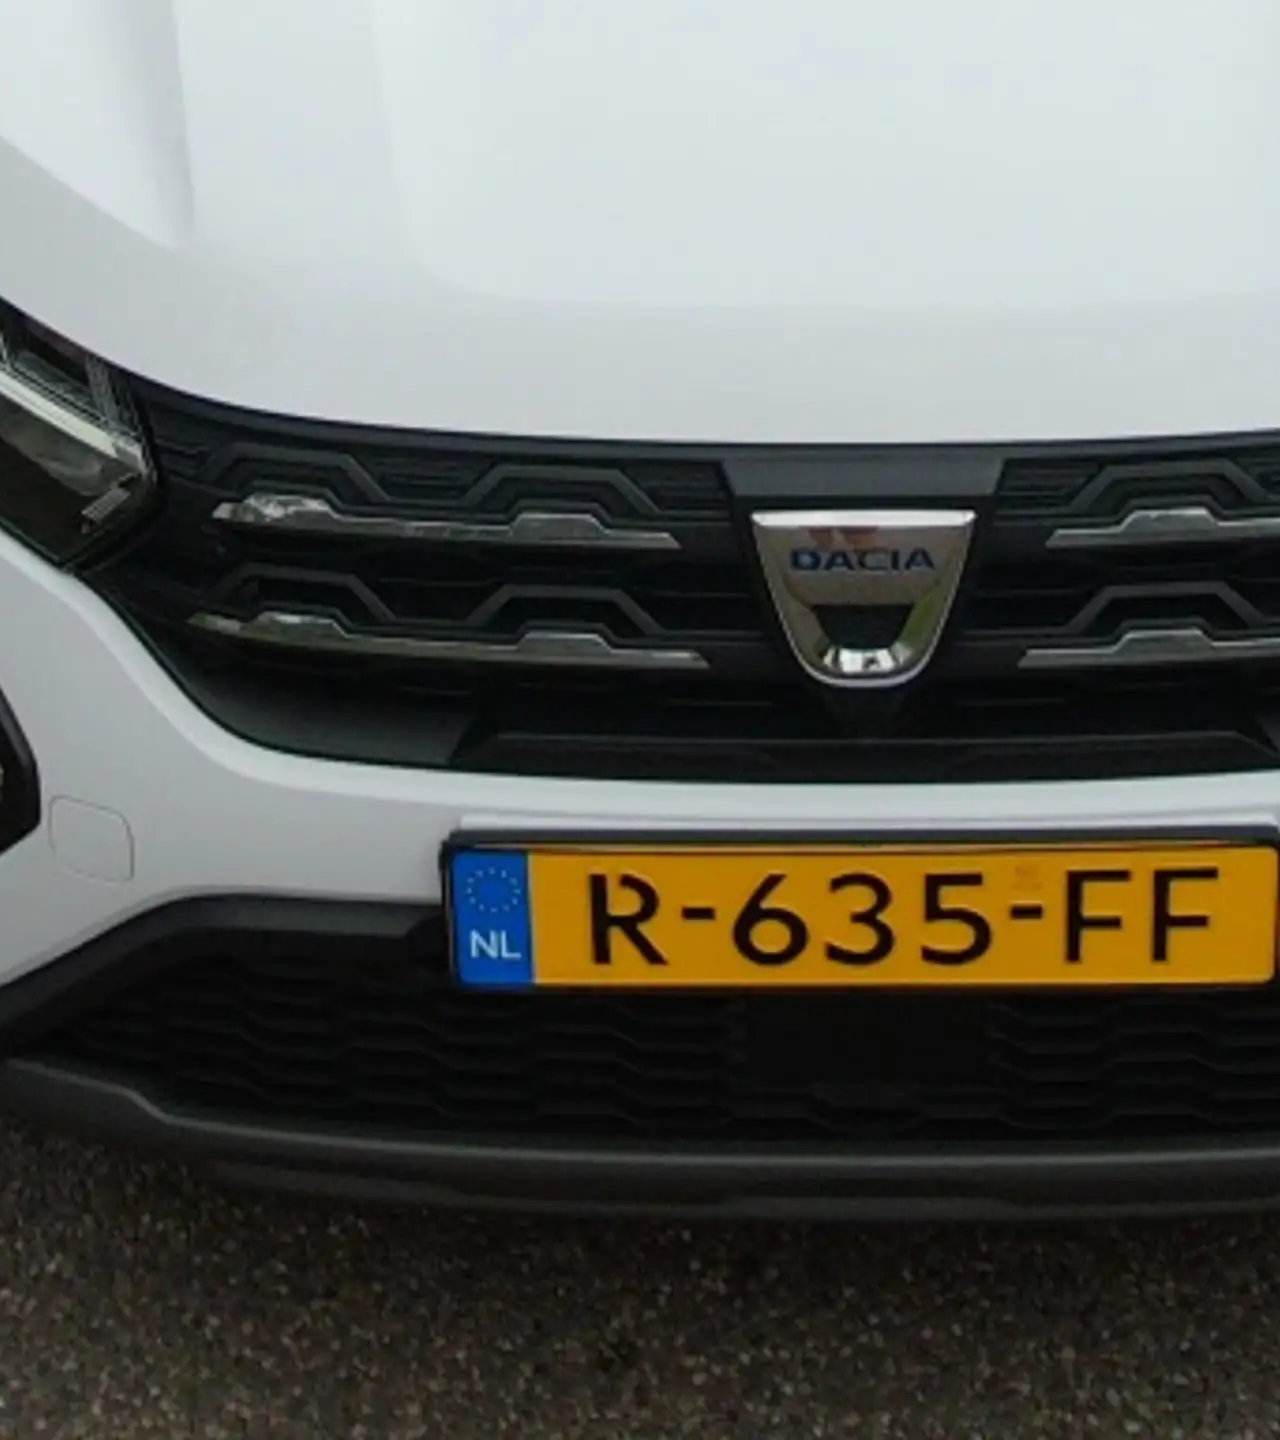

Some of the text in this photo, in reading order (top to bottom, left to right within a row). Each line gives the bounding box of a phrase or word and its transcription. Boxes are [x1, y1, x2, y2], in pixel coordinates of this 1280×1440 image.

[790, 547, 936, 571] DACIA
[588, 867, 1219, 966] R-635-FF
[469, 929, 522, 959] NL
